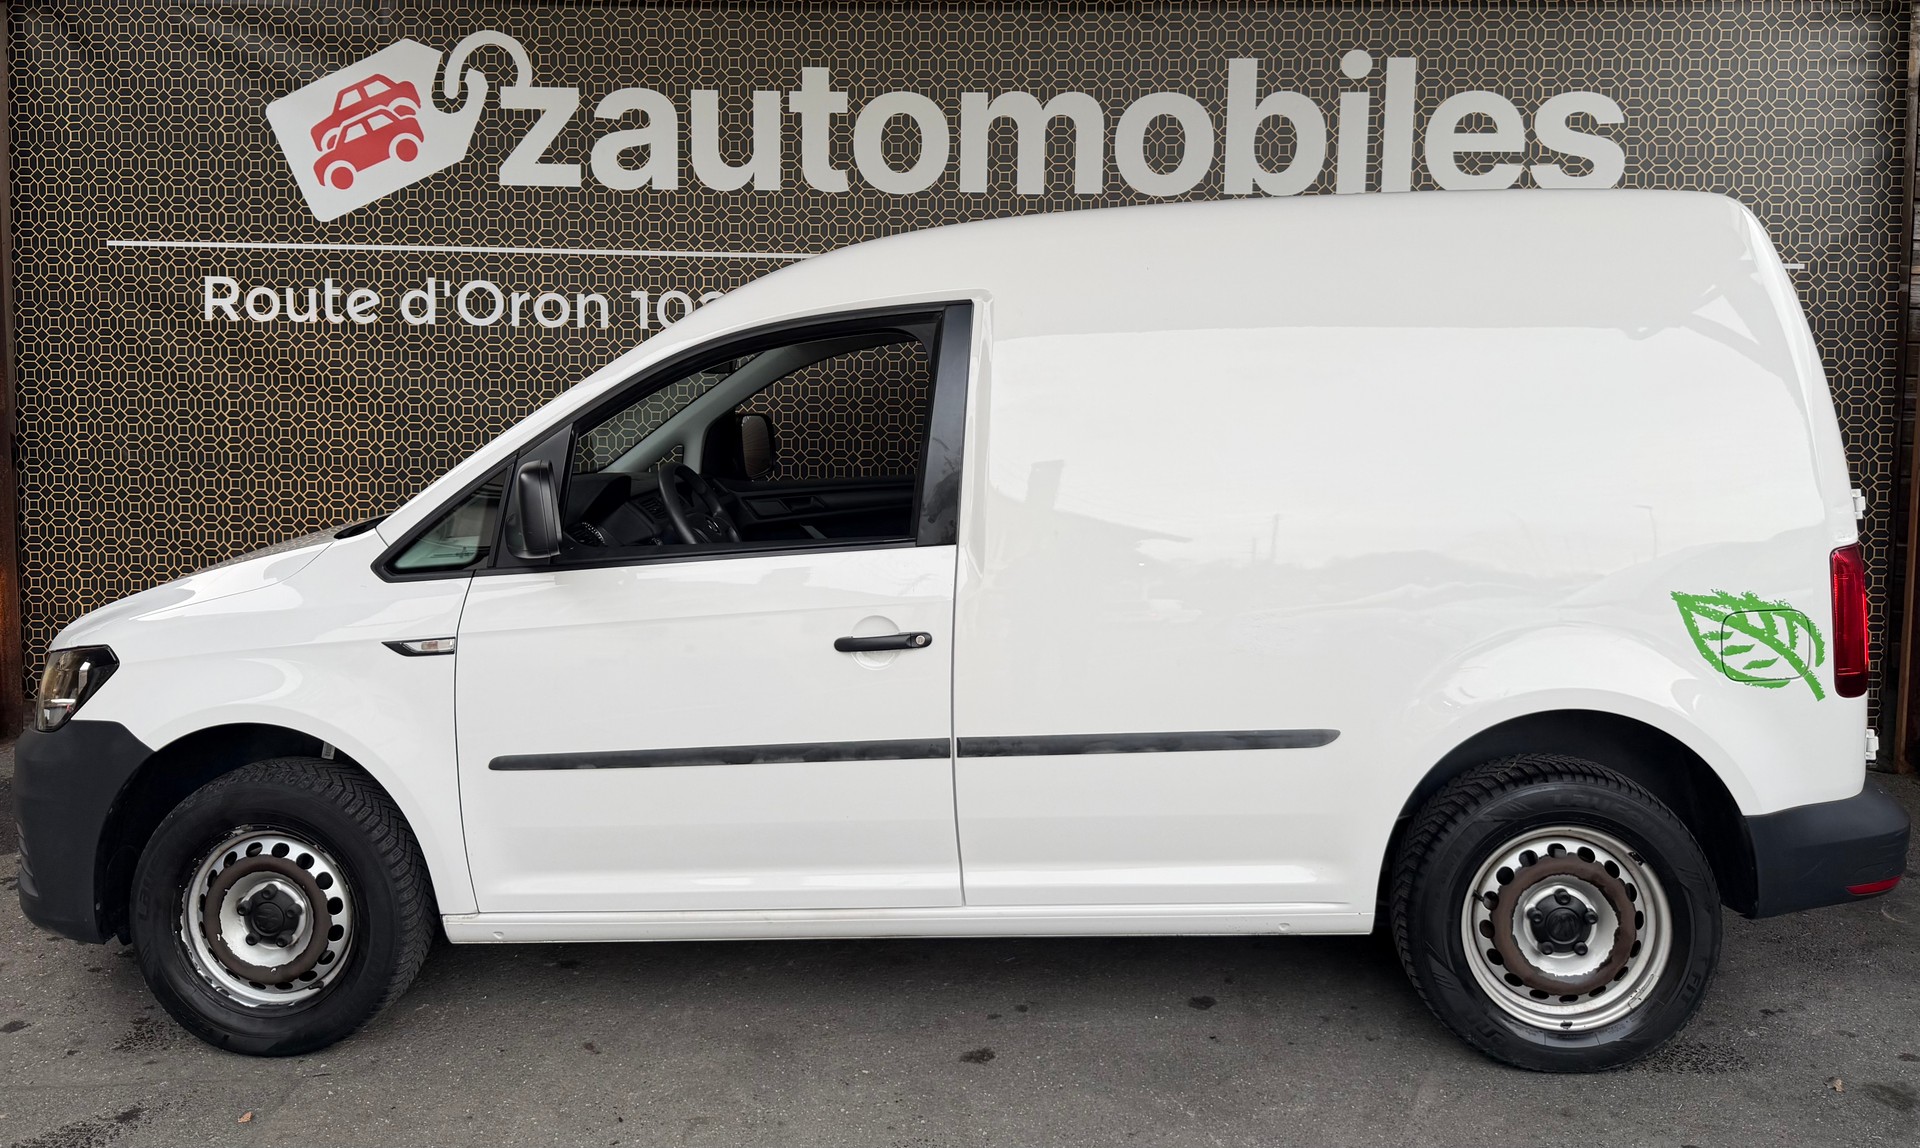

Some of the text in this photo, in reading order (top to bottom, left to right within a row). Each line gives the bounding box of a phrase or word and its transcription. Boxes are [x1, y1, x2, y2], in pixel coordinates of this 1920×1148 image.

[499, 49, 1626, 197] zautomobiles
[203, 276, 381, 324] Route
[400, 277, 609, 328] d'Oron
